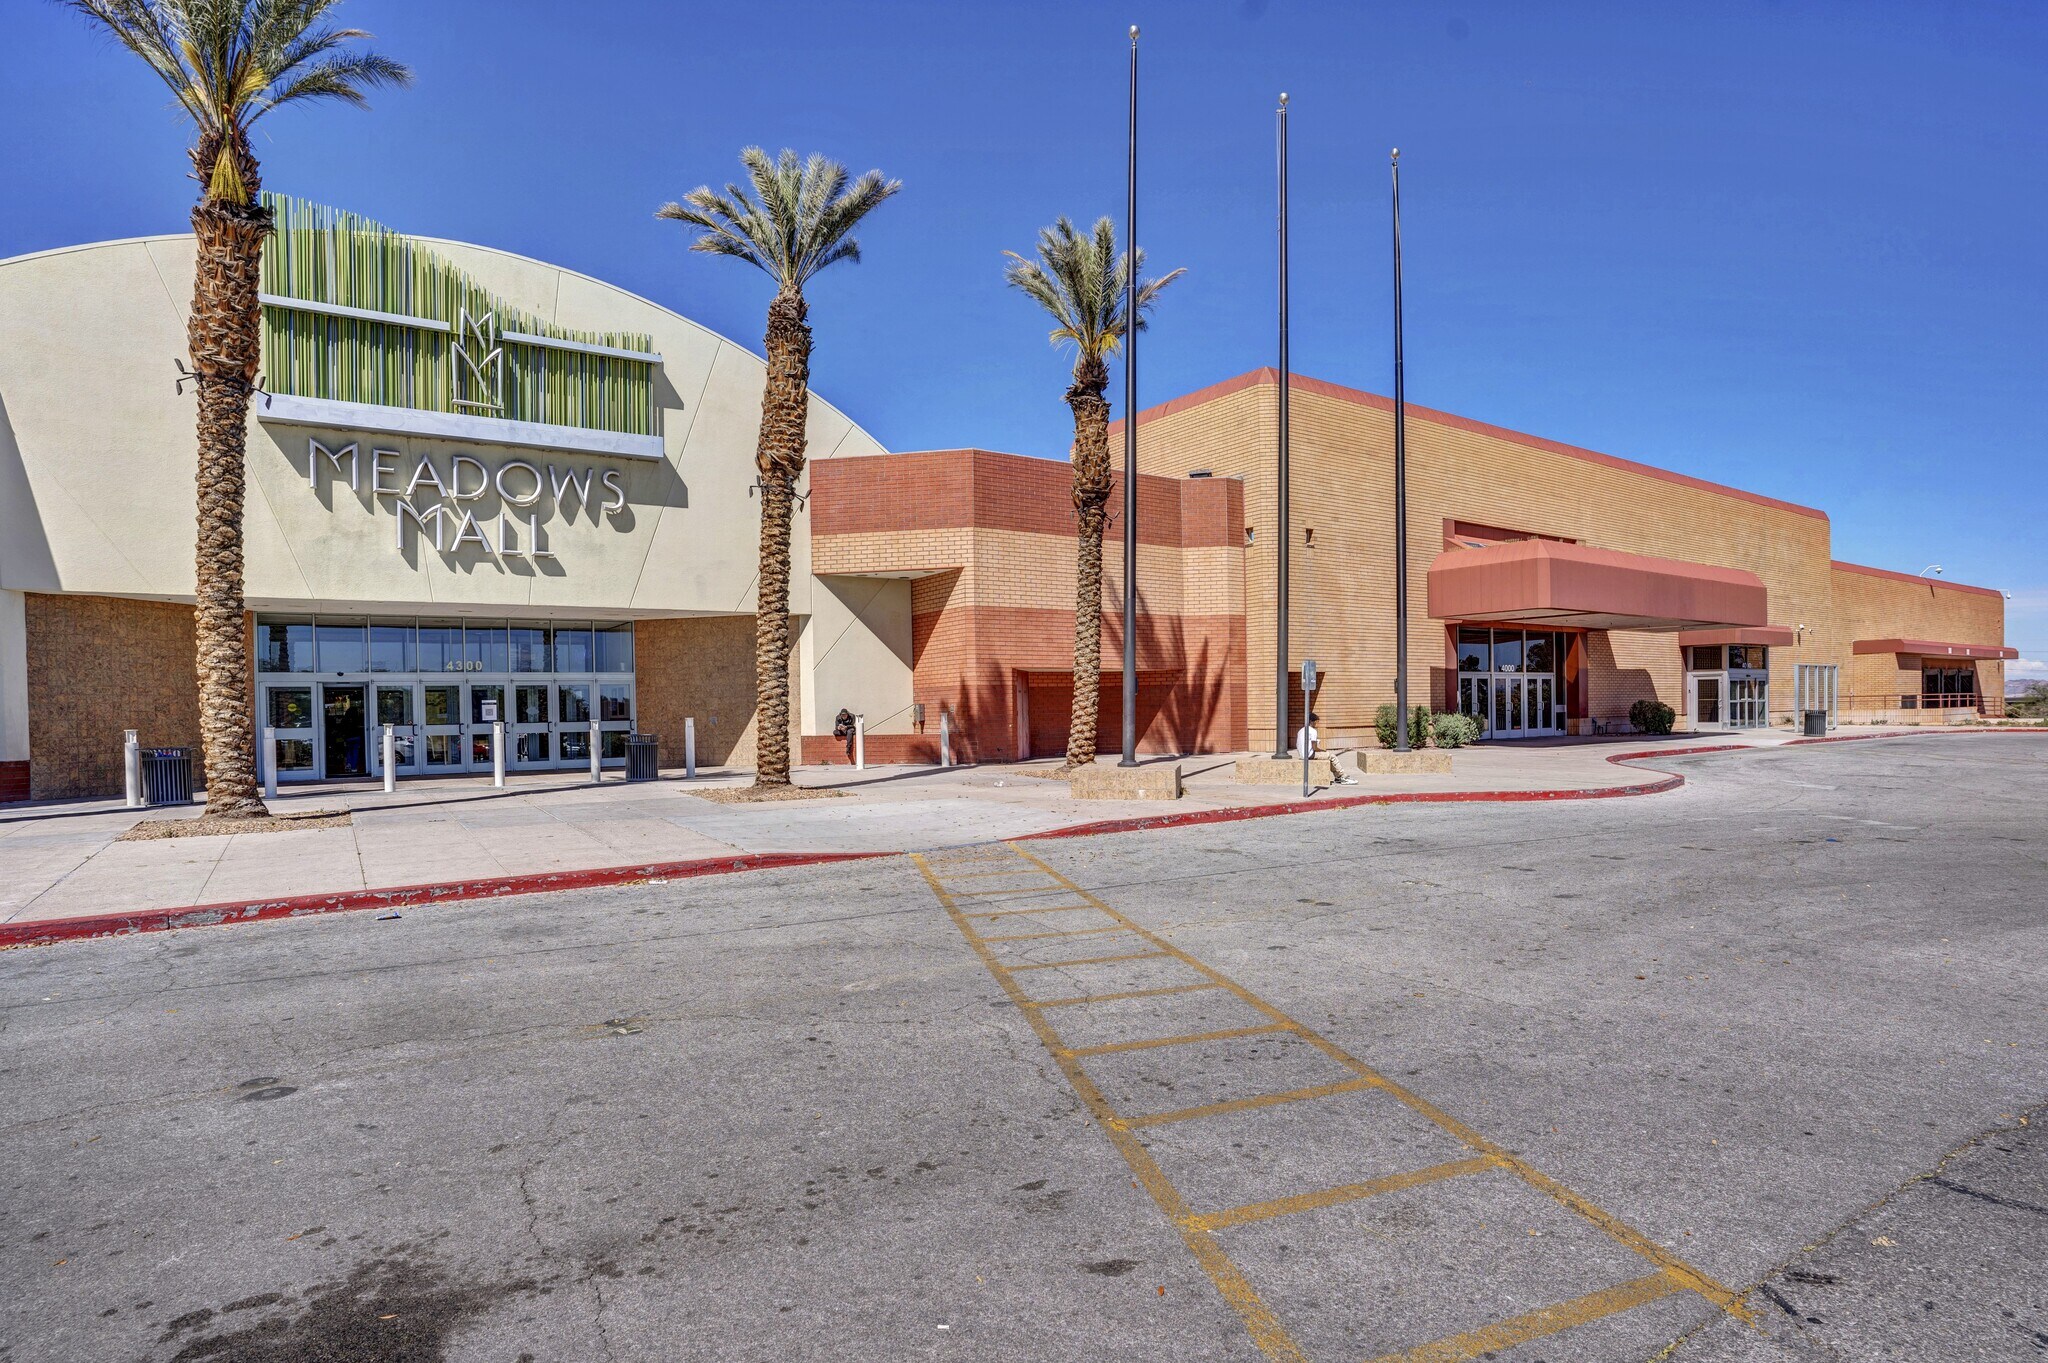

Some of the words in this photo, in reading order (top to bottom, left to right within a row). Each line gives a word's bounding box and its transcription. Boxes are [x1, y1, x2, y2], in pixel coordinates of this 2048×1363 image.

[309, 437, 625, 513] MEADOWS
[396, 500, 555, 557] MALL
[446, 660, 483, 671] 4300
[1501, 664, 1515, 672] 4000
